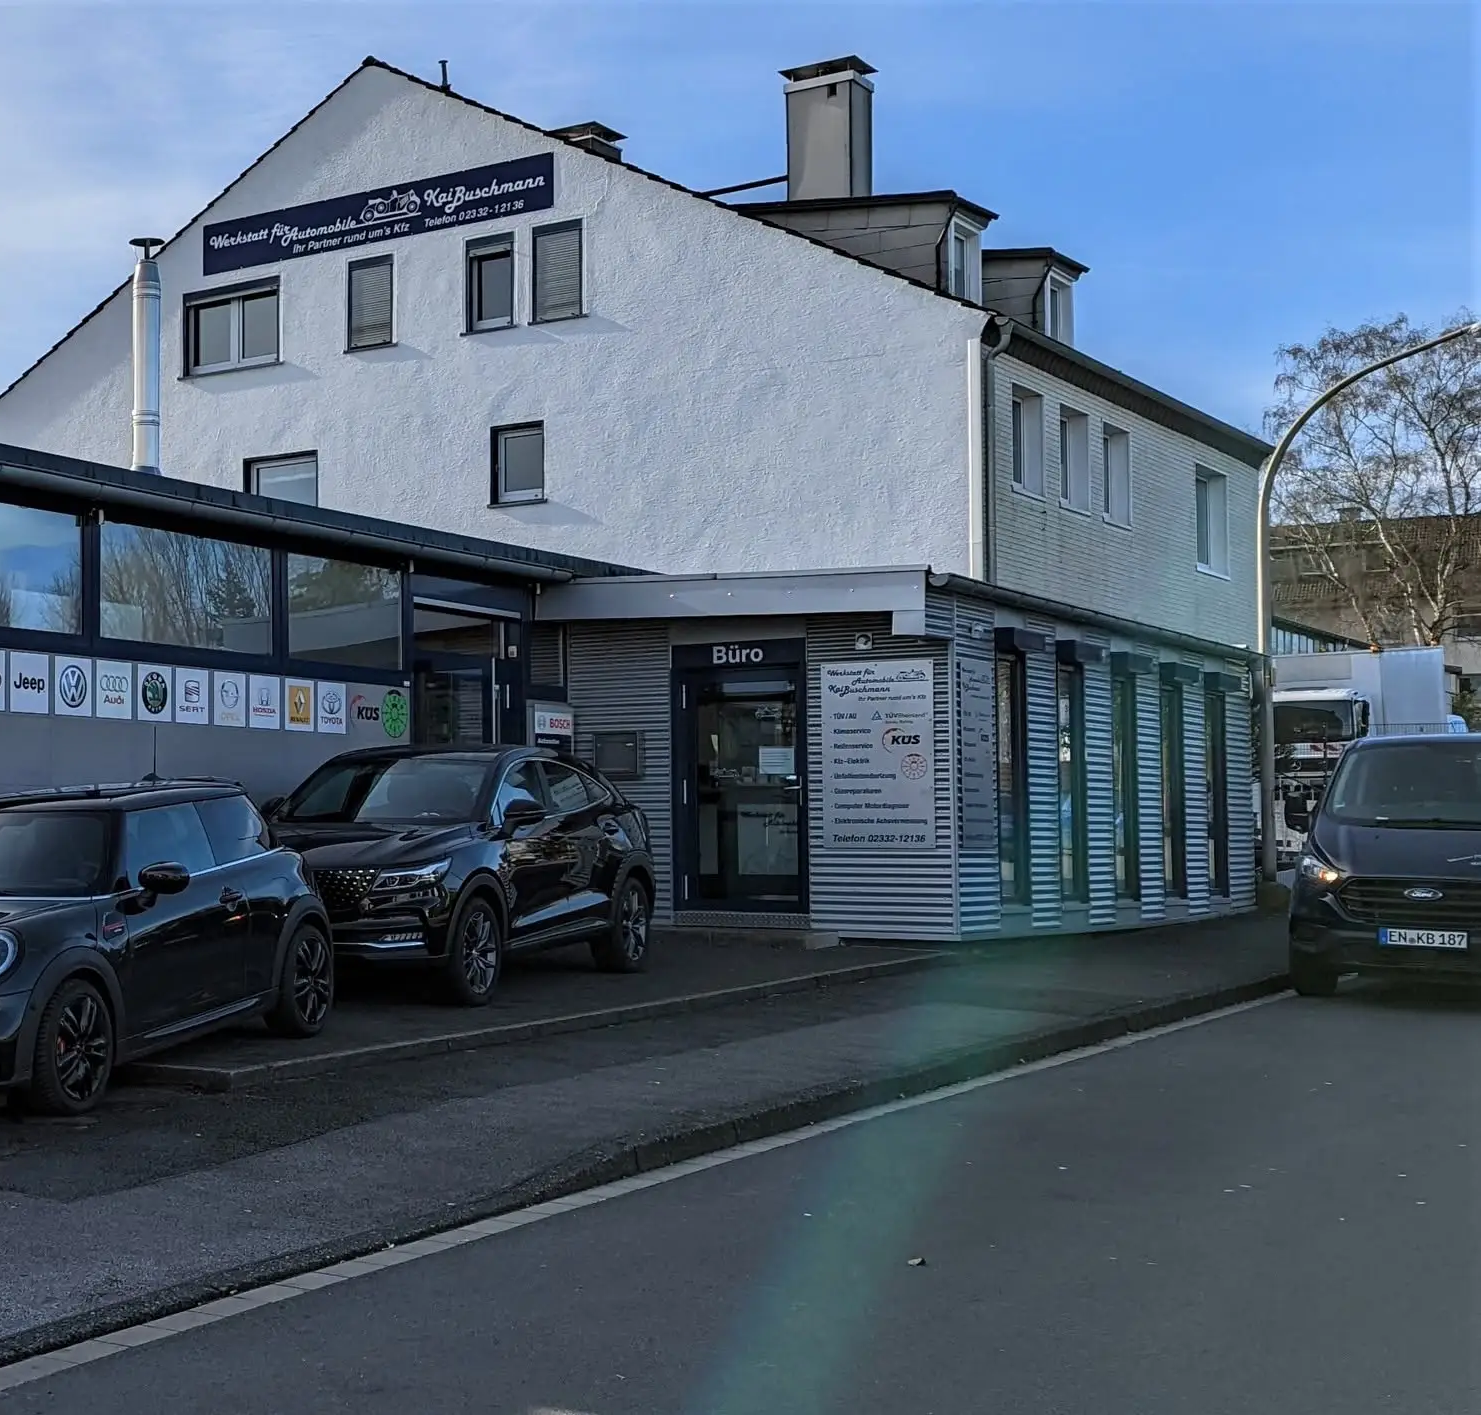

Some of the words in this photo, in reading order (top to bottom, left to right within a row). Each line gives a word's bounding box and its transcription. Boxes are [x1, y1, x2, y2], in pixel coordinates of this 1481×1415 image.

[424, 213, 456, 228] Telefon
[209, 228, 268, 250] Werkstatt
[269, 223, 292, 244] für
[281, 215, 356, 247] Automobile
[293, 242, 305, 254] Ihr
[307, 238, 342, 251] Partner
[343, 231, 366, 243] rund
[368, 226, 391, 239] um's
[393, 222, 411, 234] Kfz
[712, 646, 764, 664] Büro
[14, 672, 45, 693] Jeep
[103, 694, 124, 705] Audi
[179, 705, 205, 713] SEAT
[357, 706, 380, 721] KÜS
[321, 716, 343, 725] TOYOTA
[549, 718, 571, 729] BOSCH
[891, 735, 920, 745] KÜS
[833, 834, 865, 842] Telefon
[868, 834, 926, 843] 02332-12136
[1411, 890, 1433, 898] Ford
[1389, 931, 1407, 943] EN
[1417, 932, 1435, 945] KB
[1439, 934, 1465, 946] 187
